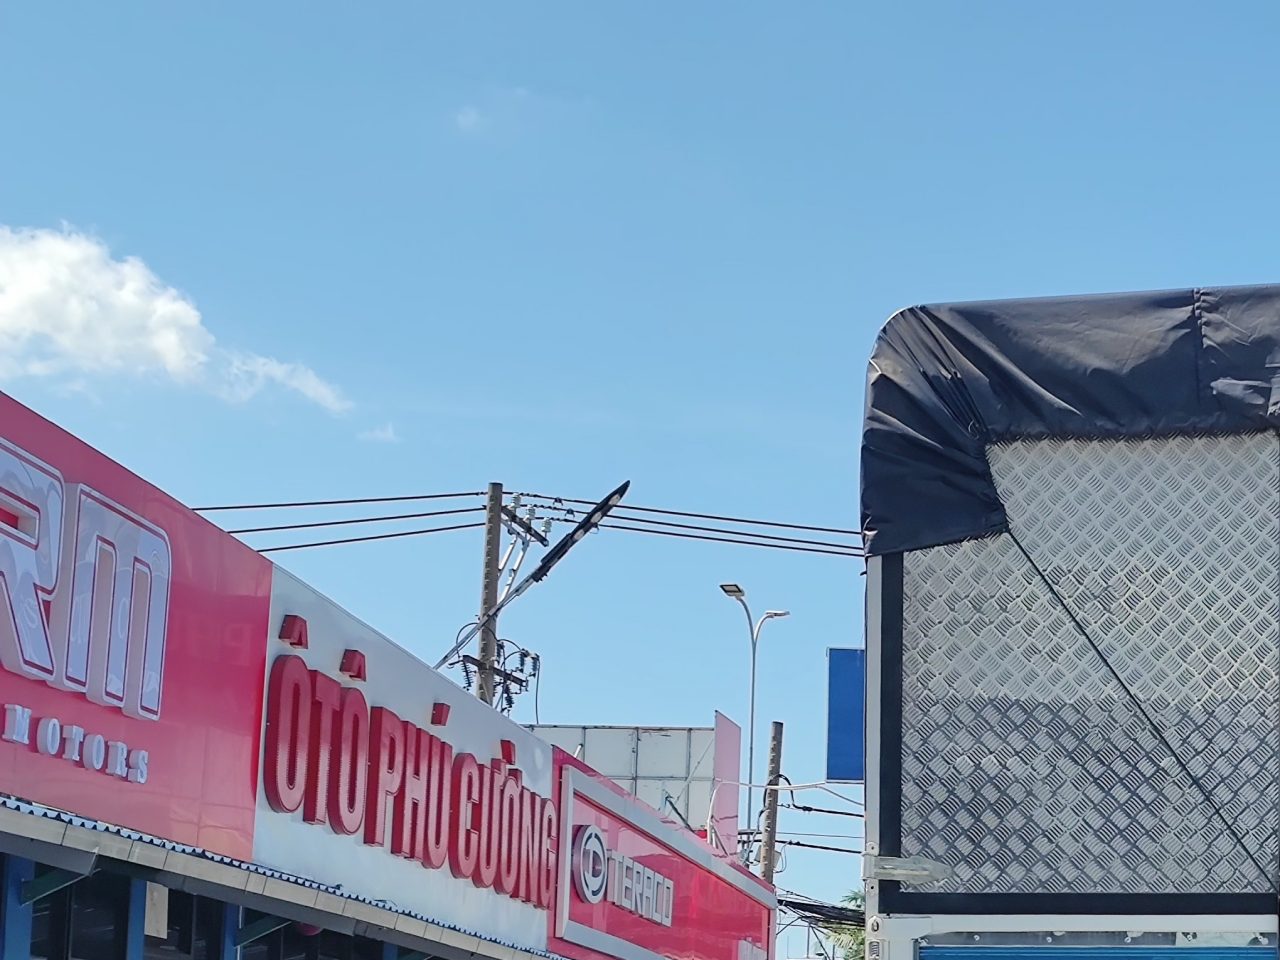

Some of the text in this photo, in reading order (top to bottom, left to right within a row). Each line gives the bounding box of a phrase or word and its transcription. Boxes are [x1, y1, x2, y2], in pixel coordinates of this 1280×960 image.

[1, 703, 149, 784] MOTORS
[363, 702, 453, 870] PHÚ
[449, 739, 558, 911] CƯỜNG
[606, 852, 675, 929] TERACO
